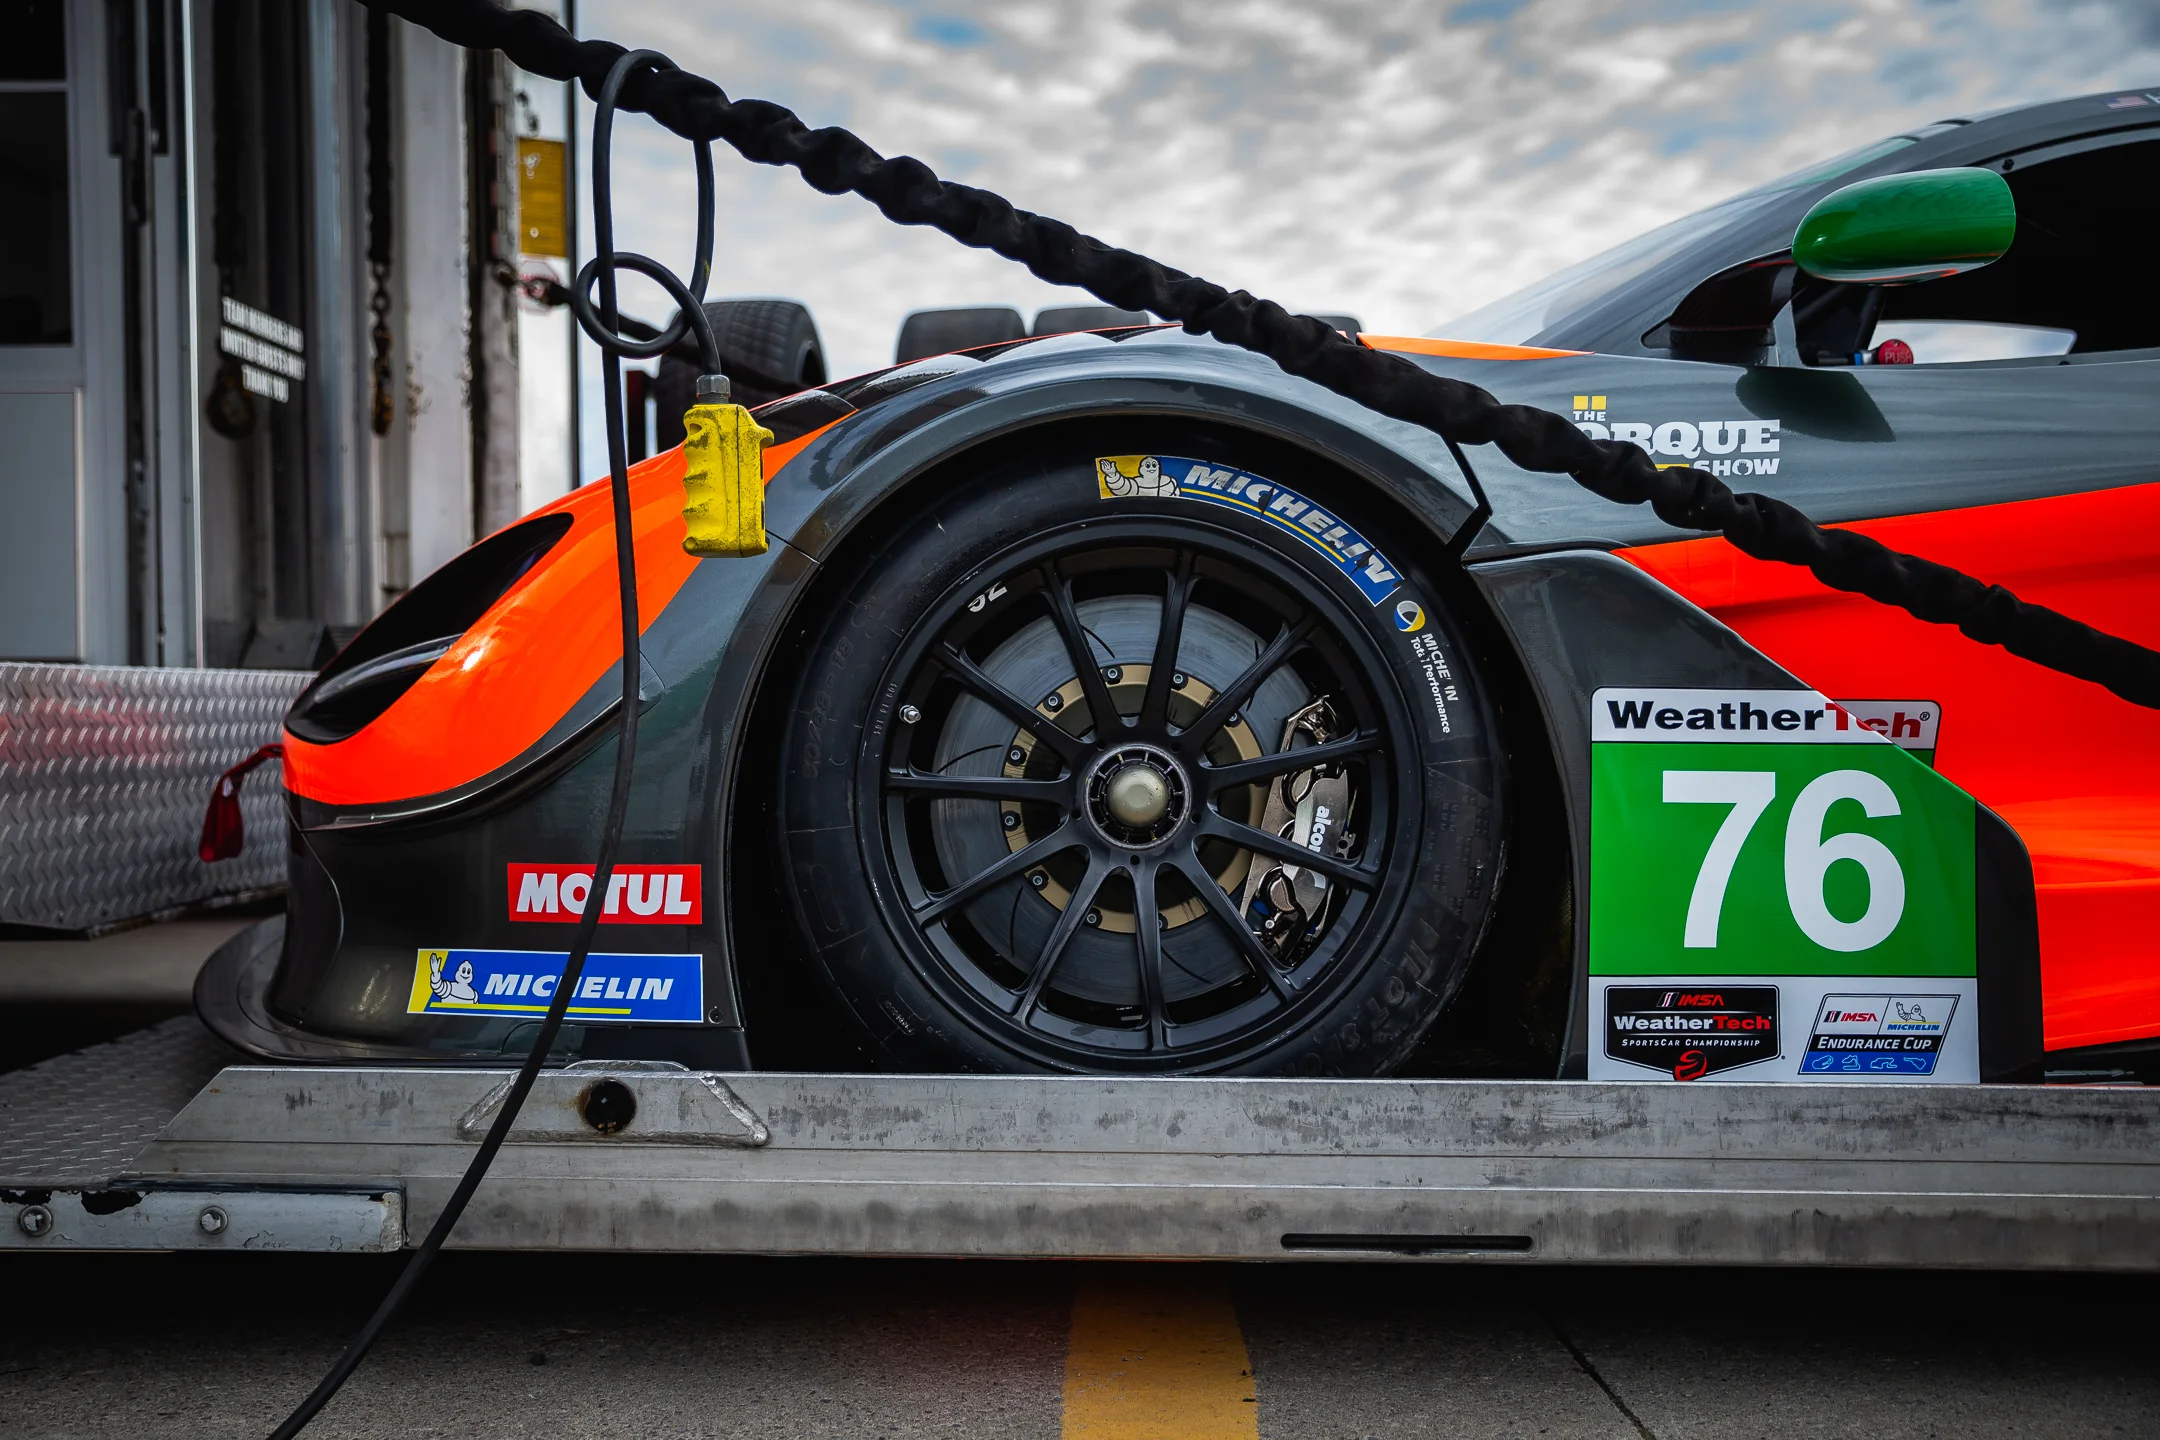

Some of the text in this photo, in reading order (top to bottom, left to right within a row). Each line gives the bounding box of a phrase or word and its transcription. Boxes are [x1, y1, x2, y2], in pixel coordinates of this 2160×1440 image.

[1885, 350, 1912, 364] PUSH
[1573, 411, 1606, 421] THE
[1693, 458, 1780, 476] SHOW
[1183, 465, 1396, 584] MICHELIN
[1422, 633, 1459, 701] MICHEIN
[1422, 664, 1451, 734] Performance
[1663, 769, 1906, 952] 76
[516, 872, 692, 916] MOTUL
[484, 973, 674, 1001] MICELIN
[1678, 994, 1725, 1007] IMSA
[1840, 1012, 1879, 1023] IMSA
[1887, 1023, 1940, 1031] MICHELIN
[1903, 1037, 1932, 1050] CUP
